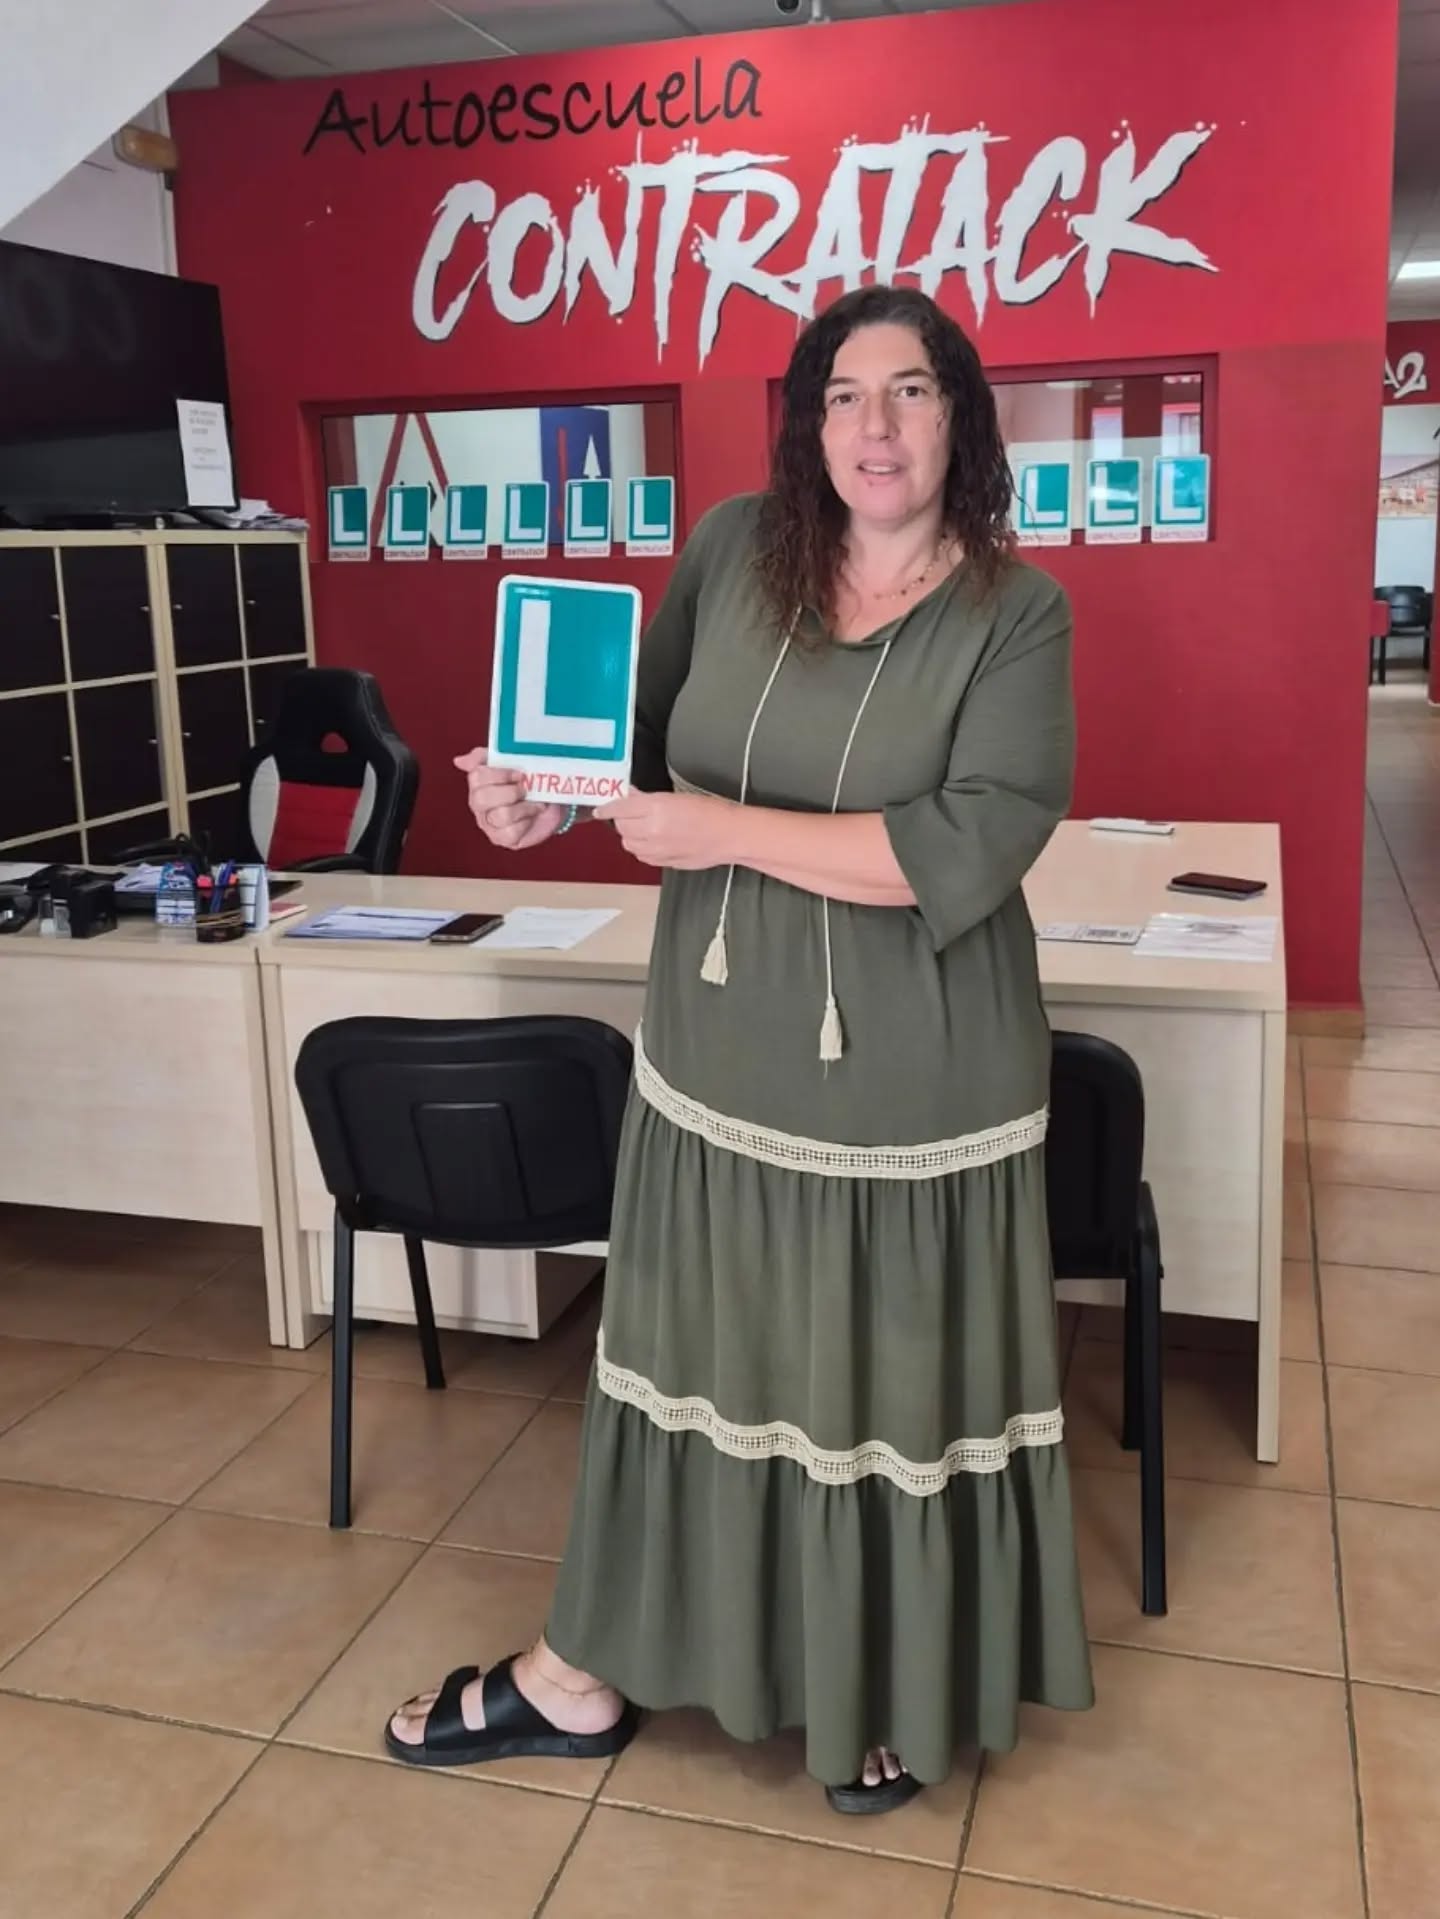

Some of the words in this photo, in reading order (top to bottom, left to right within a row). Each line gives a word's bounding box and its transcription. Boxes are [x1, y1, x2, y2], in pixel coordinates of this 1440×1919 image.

[303, 56, 763, 155] Autoescuela
[411, 114, 1219, 372] CONTRATACK
[332, 492, 365, 541] L
[391, 492, 425, 541] L
[450, 490, 484, 540] L
[508, 489, 542, 539] L
[571, 486, 605, 538] L
[633, 484, 668, 536] L
[1024, 468, 1064, 523] L
[1094, 466, 1135, 521] L
[1160, 462, 1202, 521] L
[513, 598, 616, 749] L
[522, 773, 623, 797] NTRATACK
